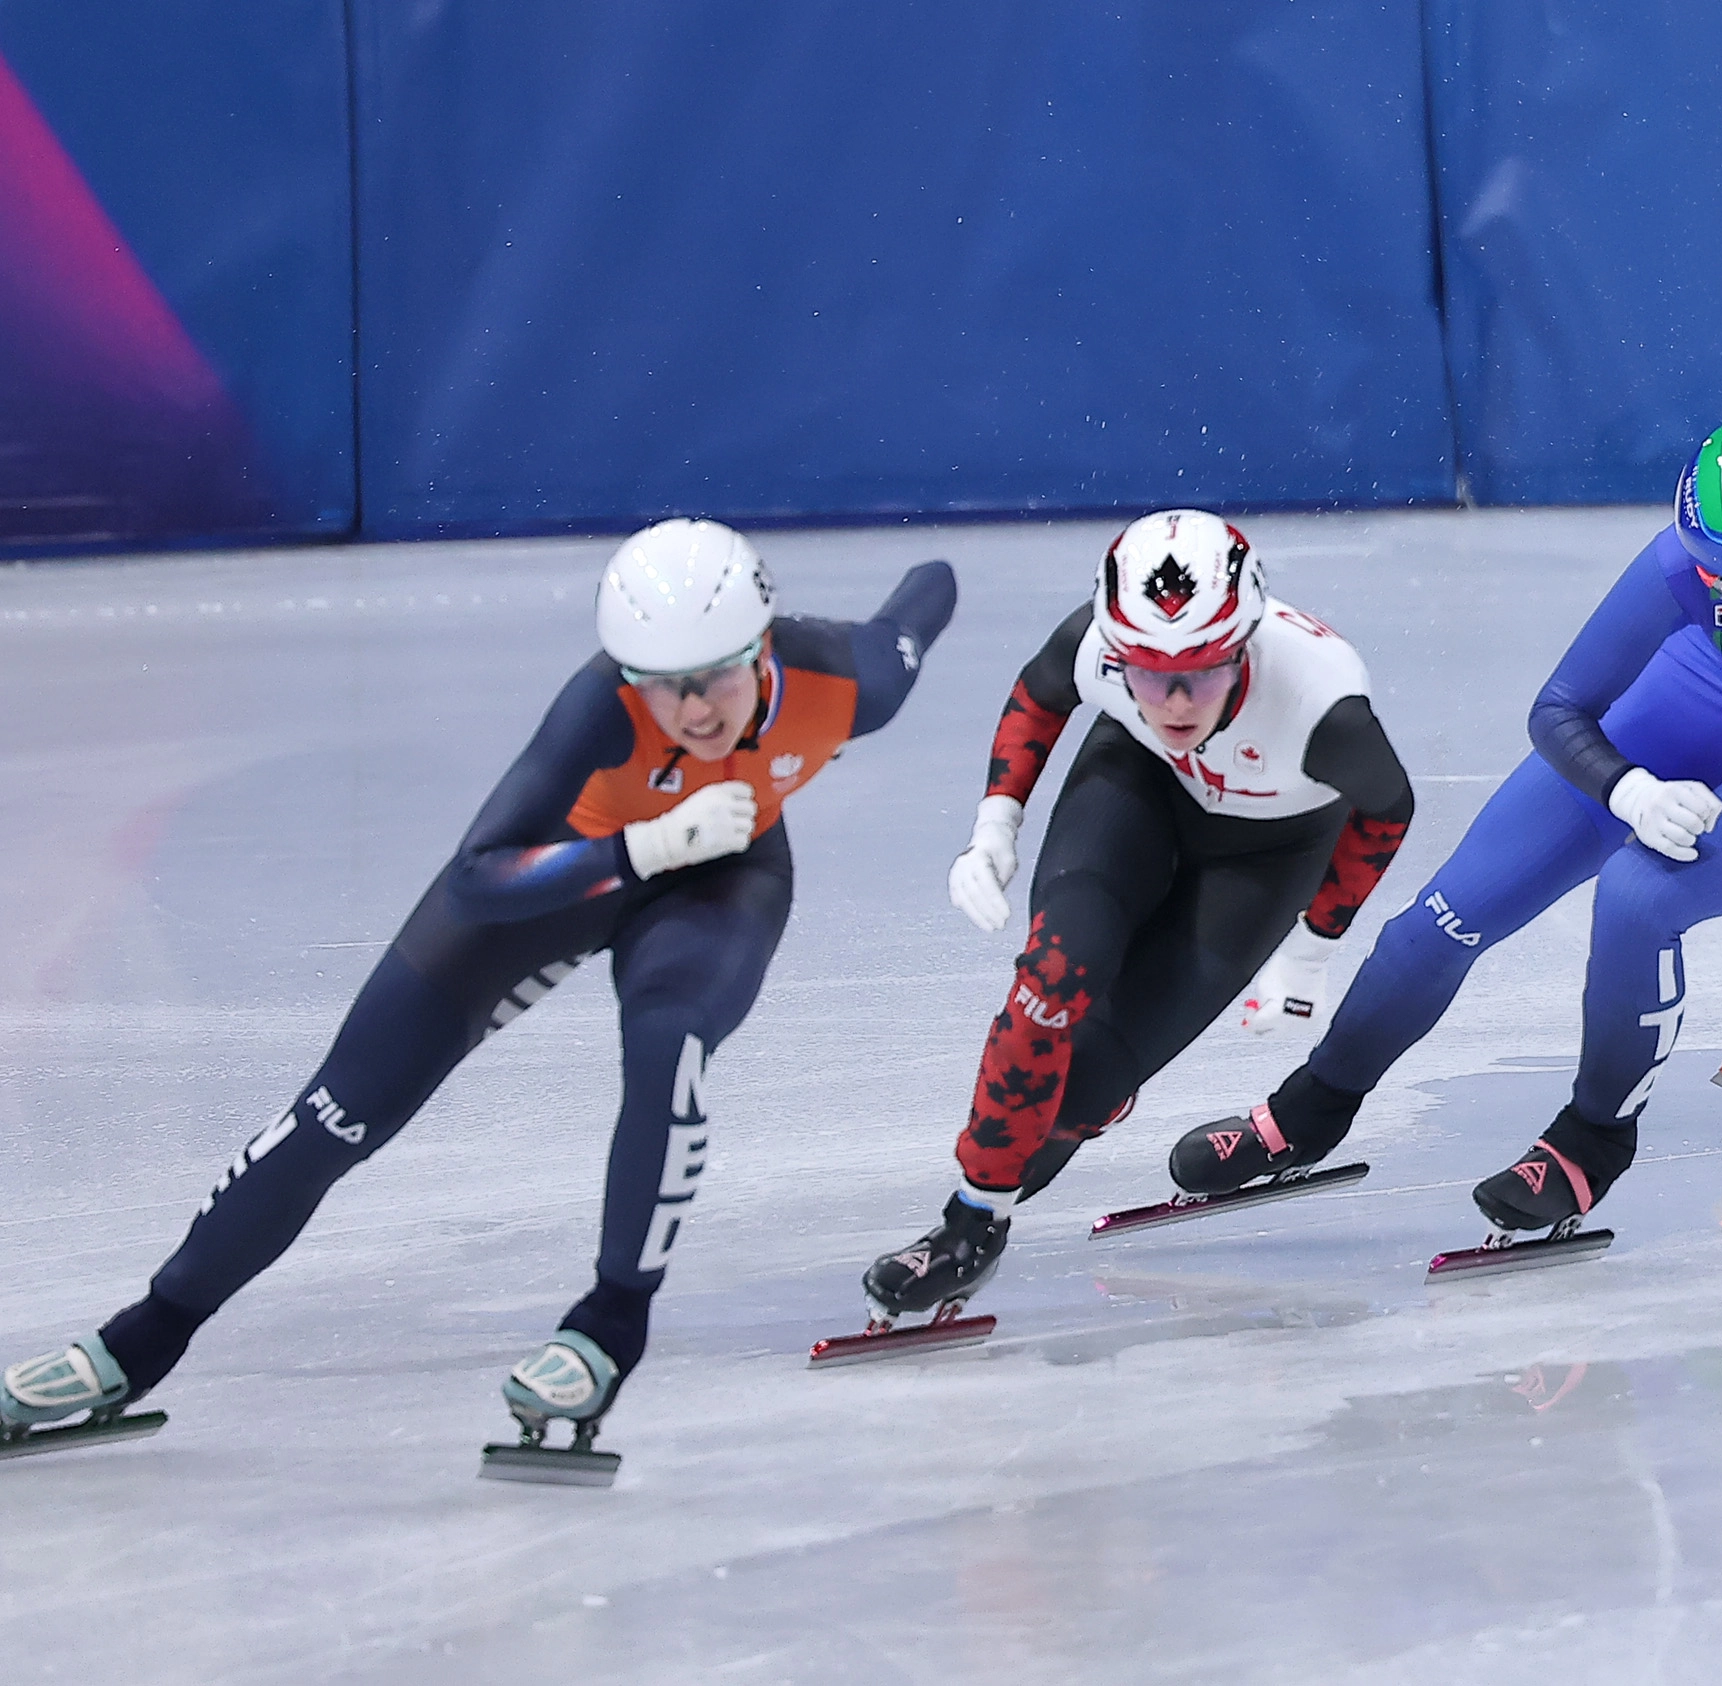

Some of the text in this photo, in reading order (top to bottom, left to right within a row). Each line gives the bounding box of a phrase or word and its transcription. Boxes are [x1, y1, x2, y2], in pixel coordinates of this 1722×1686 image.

[1425, 891, 1481, 947] FILA
[1014, 984, 1069, 1029] FILA
[1615, 948, 1685, 1119] ITA
[306, 1085, 368, 1145] FILA
[638, 1032, 707, 1272] NED
